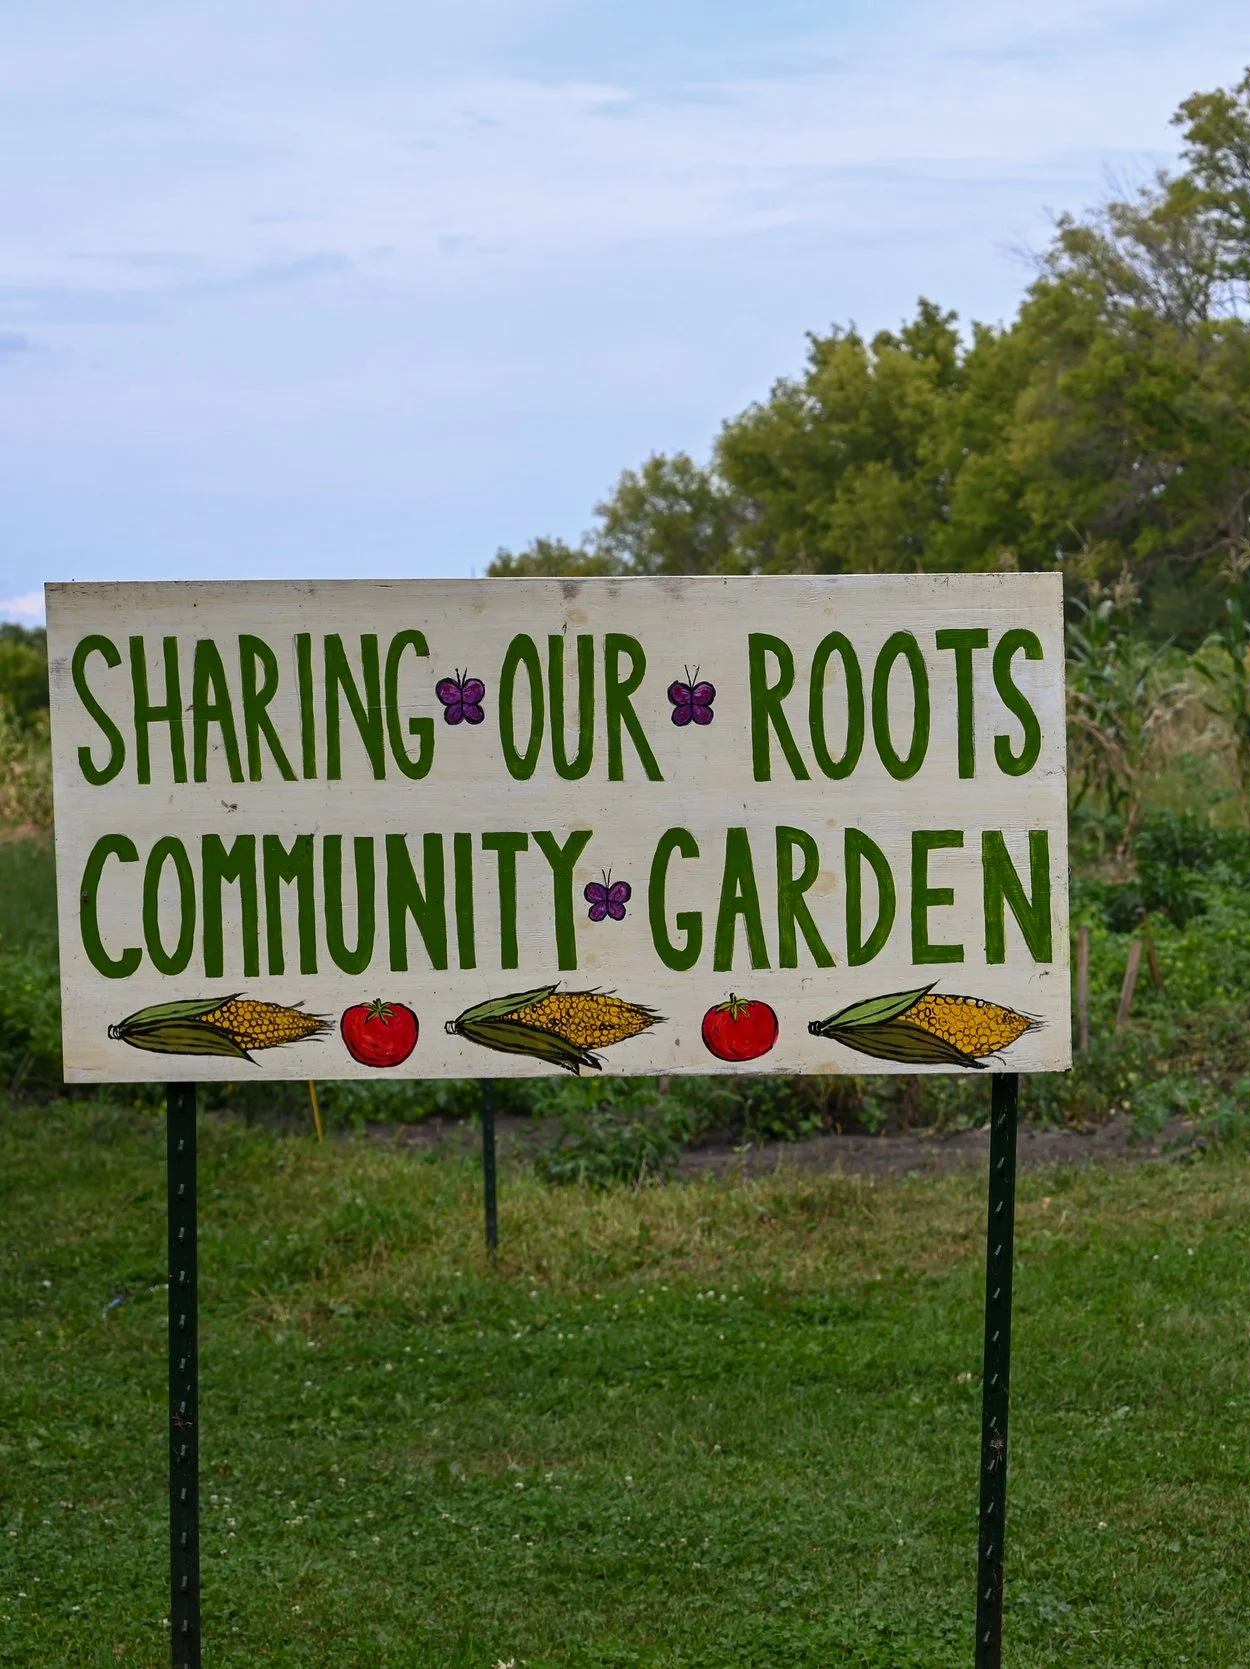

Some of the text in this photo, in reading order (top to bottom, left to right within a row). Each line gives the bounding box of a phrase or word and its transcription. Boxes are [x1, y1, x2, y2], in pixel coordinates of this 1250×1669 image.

[71, 627, 1044, 786] SHARING OUR ROOTS
[80, 825, 1053, 980] COMMUNITY GARDEN
